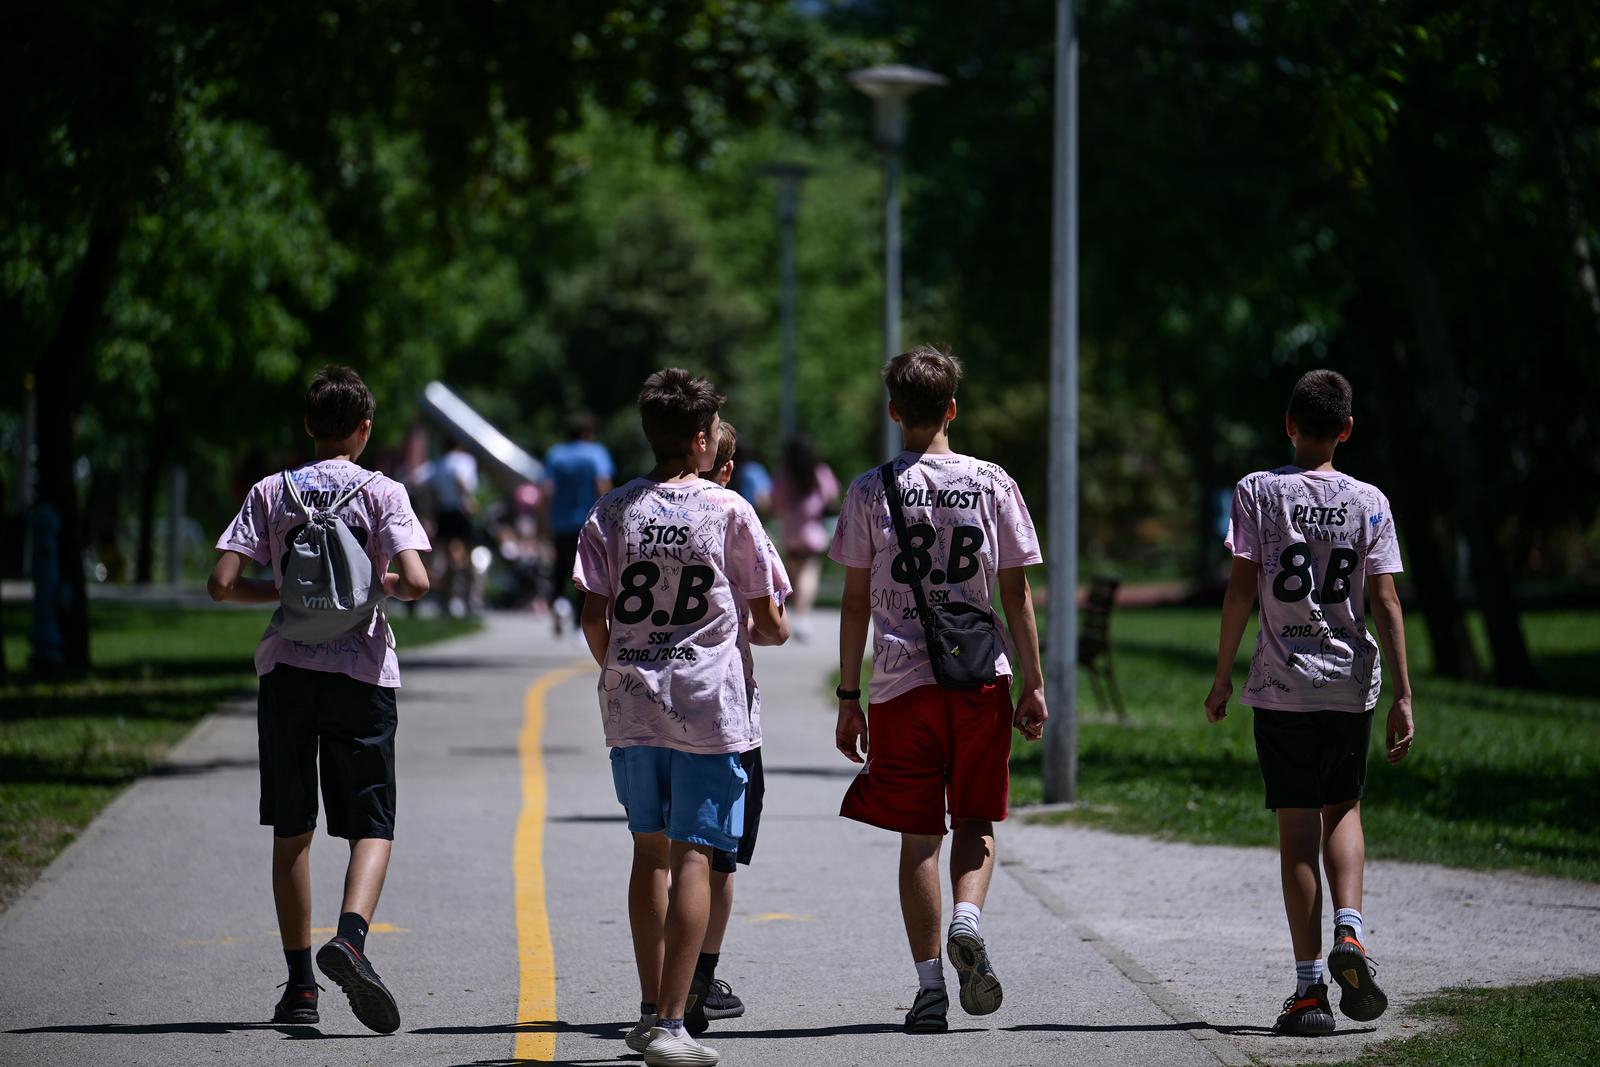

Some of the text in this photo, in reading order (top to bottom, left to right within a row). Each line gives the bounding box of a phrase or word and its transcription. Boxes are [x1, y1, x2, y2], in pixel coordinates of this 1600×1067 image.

[936, 489, 982, 510] KOST
[1292, 502, 1348, 526] PLETEŠ
[642, 518, 690, 545] ŠTOS
[891, 523, 985, 584] 8.B
[1272, 541, 1359, 605] 8.B
[614, 560, 715, 627] 8.B
[929, 589, 951, 603] SSK
[648, 631, 674, 645] SSK
[617, 647, 697, 662] 2018./2026.
